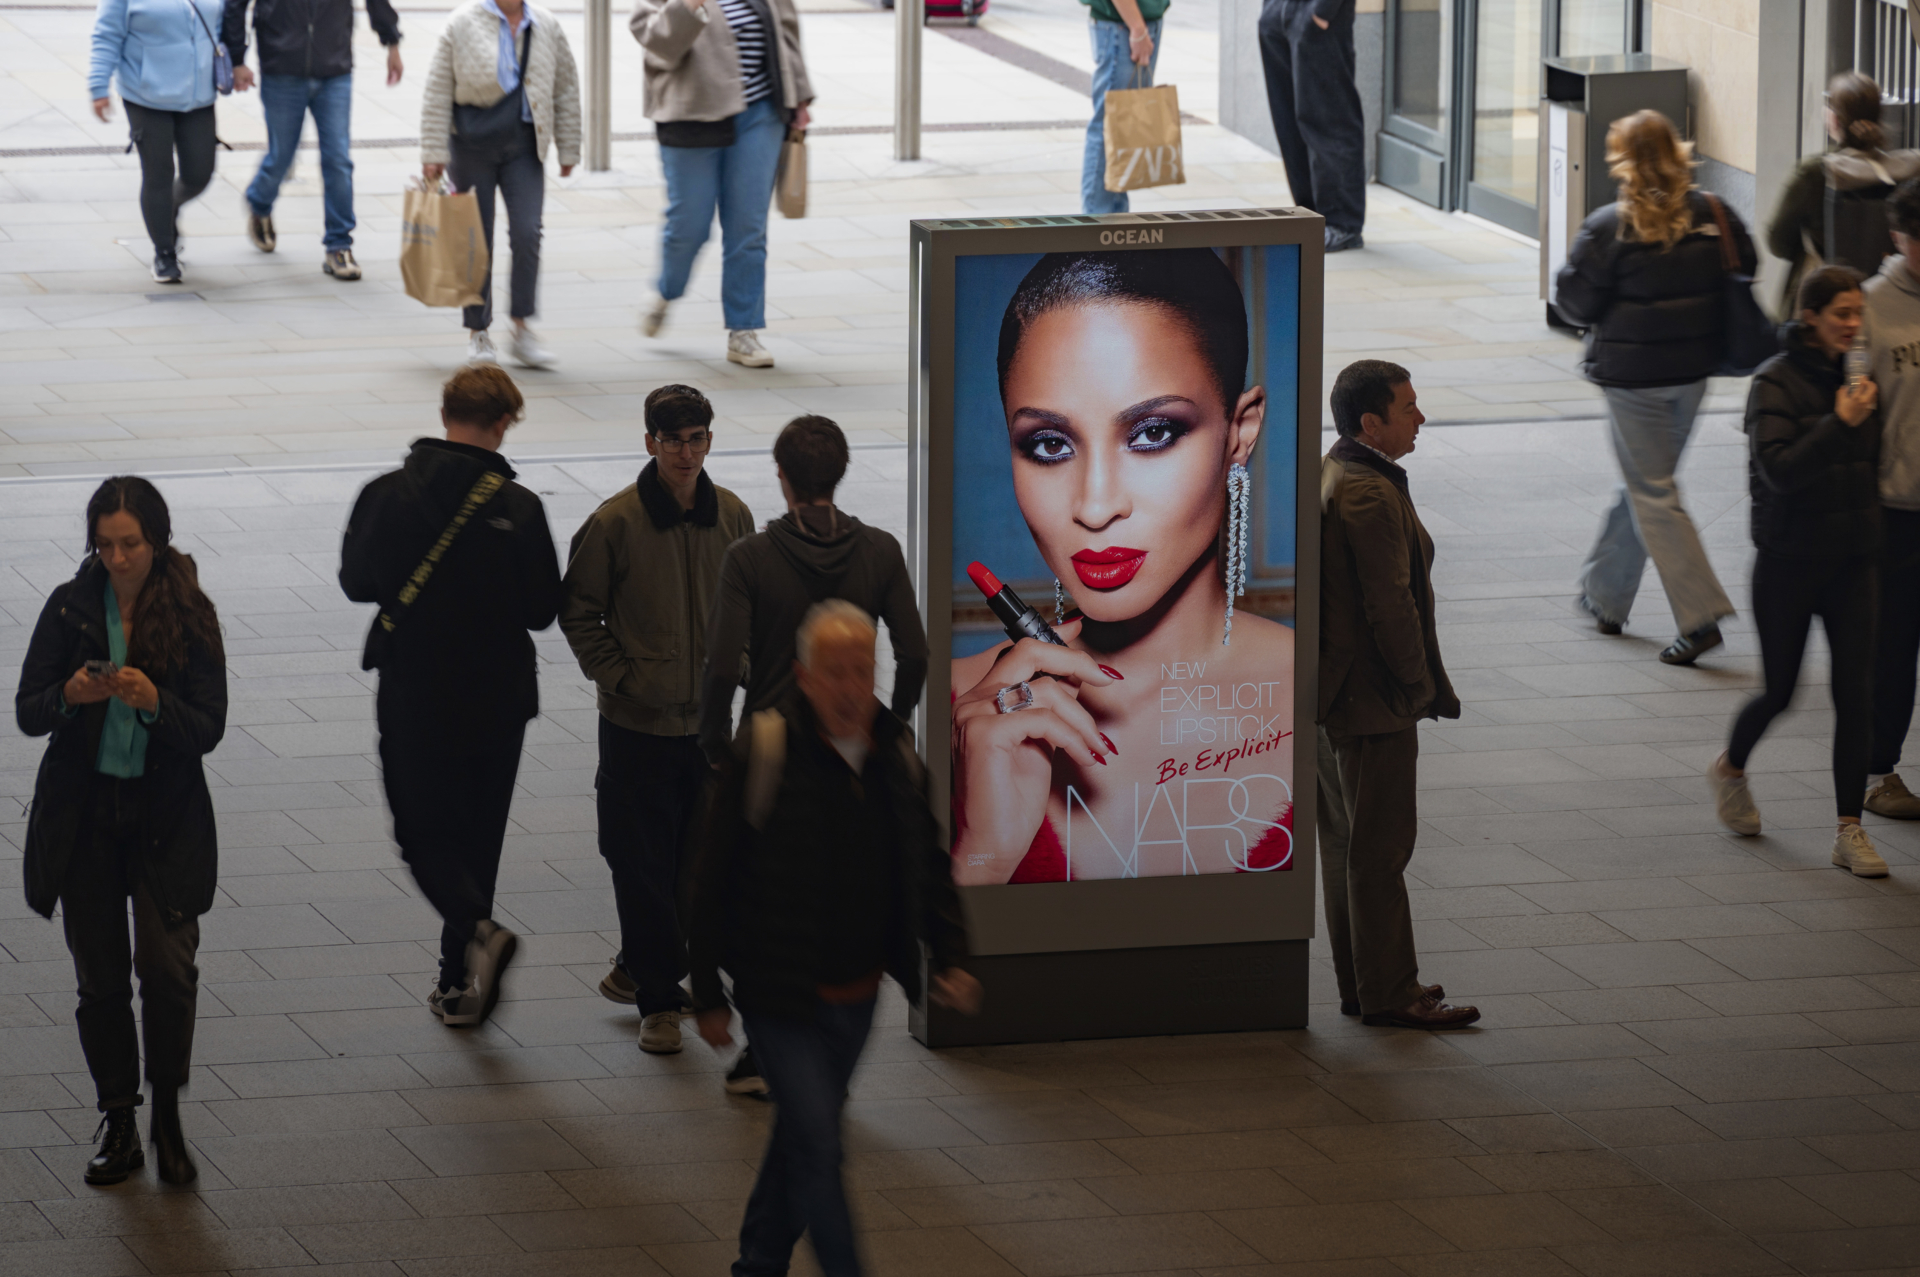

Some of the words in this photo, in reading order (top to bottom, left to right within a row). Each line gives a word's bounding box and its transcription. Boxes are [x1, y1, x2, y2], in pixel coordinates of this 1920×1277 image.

[1117, 143, 1183, 187] ZAR
[1100, 228, 1163, 245] OCEAN
[1161, 661, 1206, 680] NEW
[1161, 681, 1280, 712] EXPLICIT
[1160, 714, 1280, 745] LIPSTICK
[1156, 758, 1189, 785] Be
[1195, 730, 1293, 772] Explicit
[1066, 774, 1294, 882] NARS
[967, 852, 995, 860] STARRING
